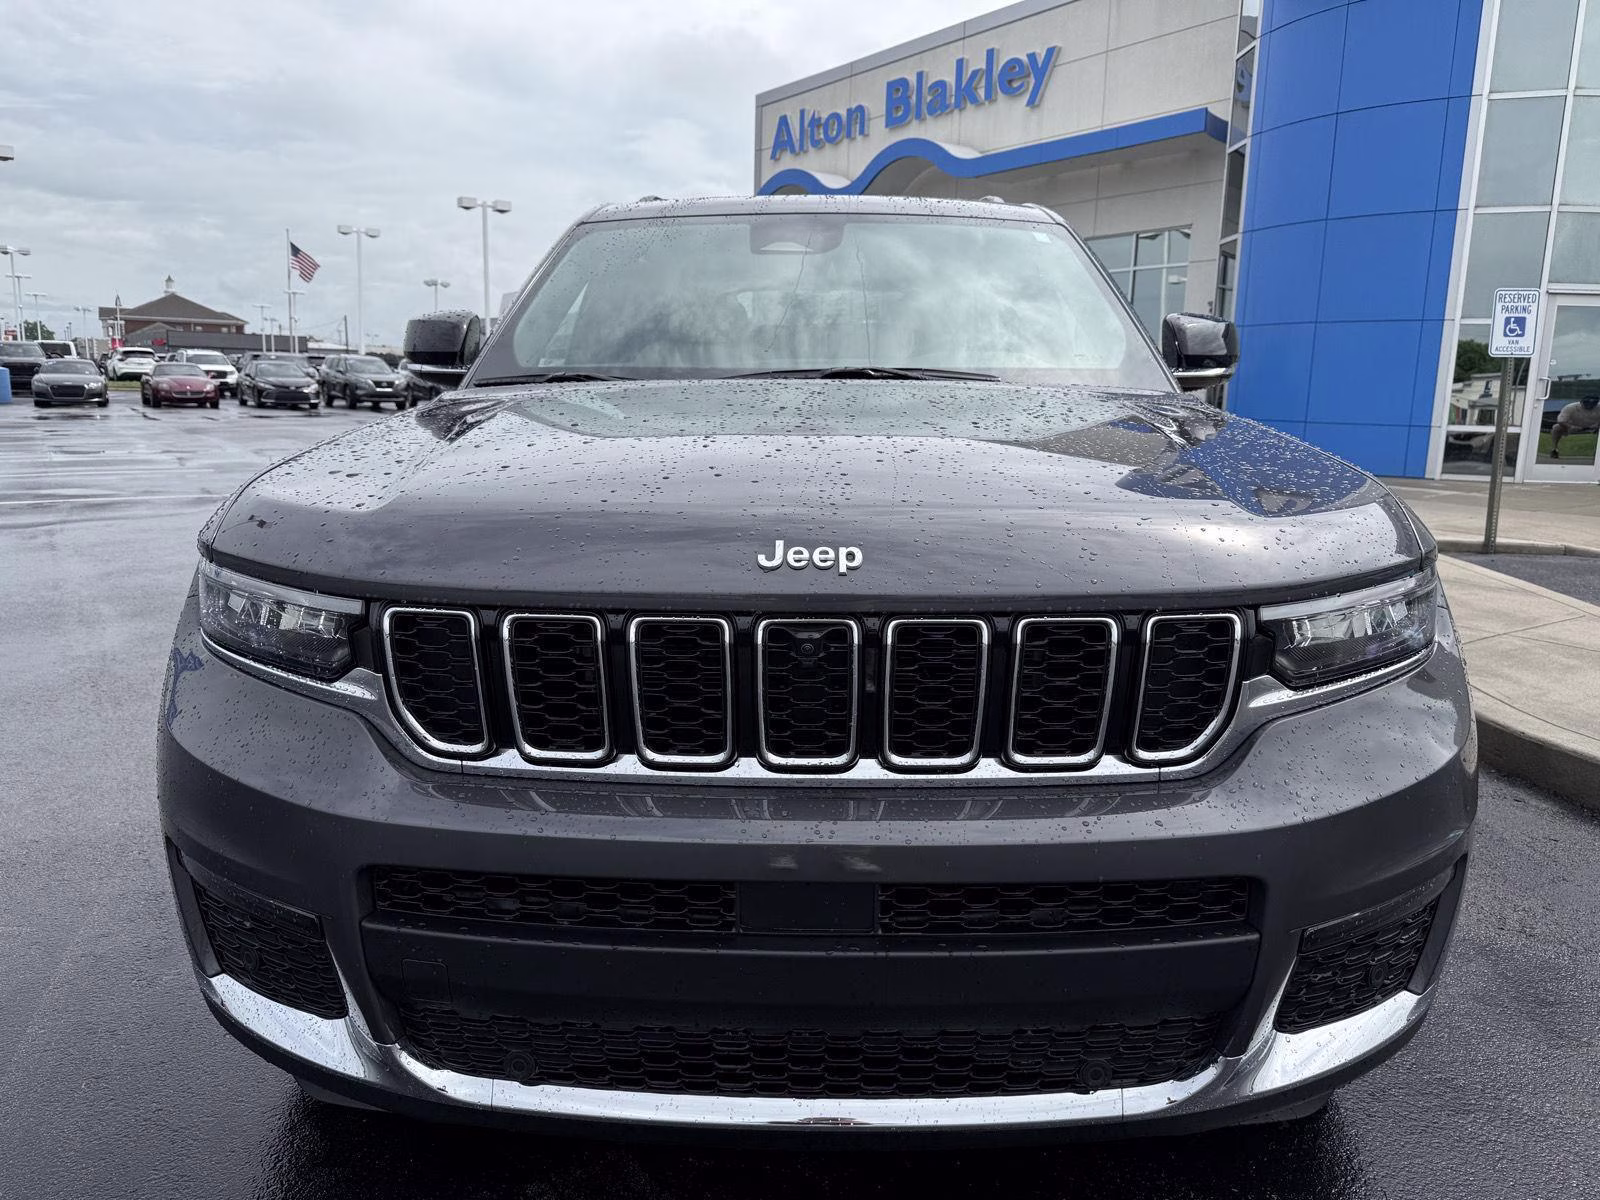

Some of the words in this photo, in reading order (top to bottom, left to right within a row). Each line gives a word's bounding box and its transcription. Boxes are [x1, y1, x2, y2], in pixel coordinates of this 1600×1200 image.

[770, 103, 868, 160] Alton
[885, 46, 1061, 129] Blakley
[1498, 293, 1537, 303] RESERVED
[1501, 305, 1532, 314] PARKING
[757, 540, 864, 576] Jeep
